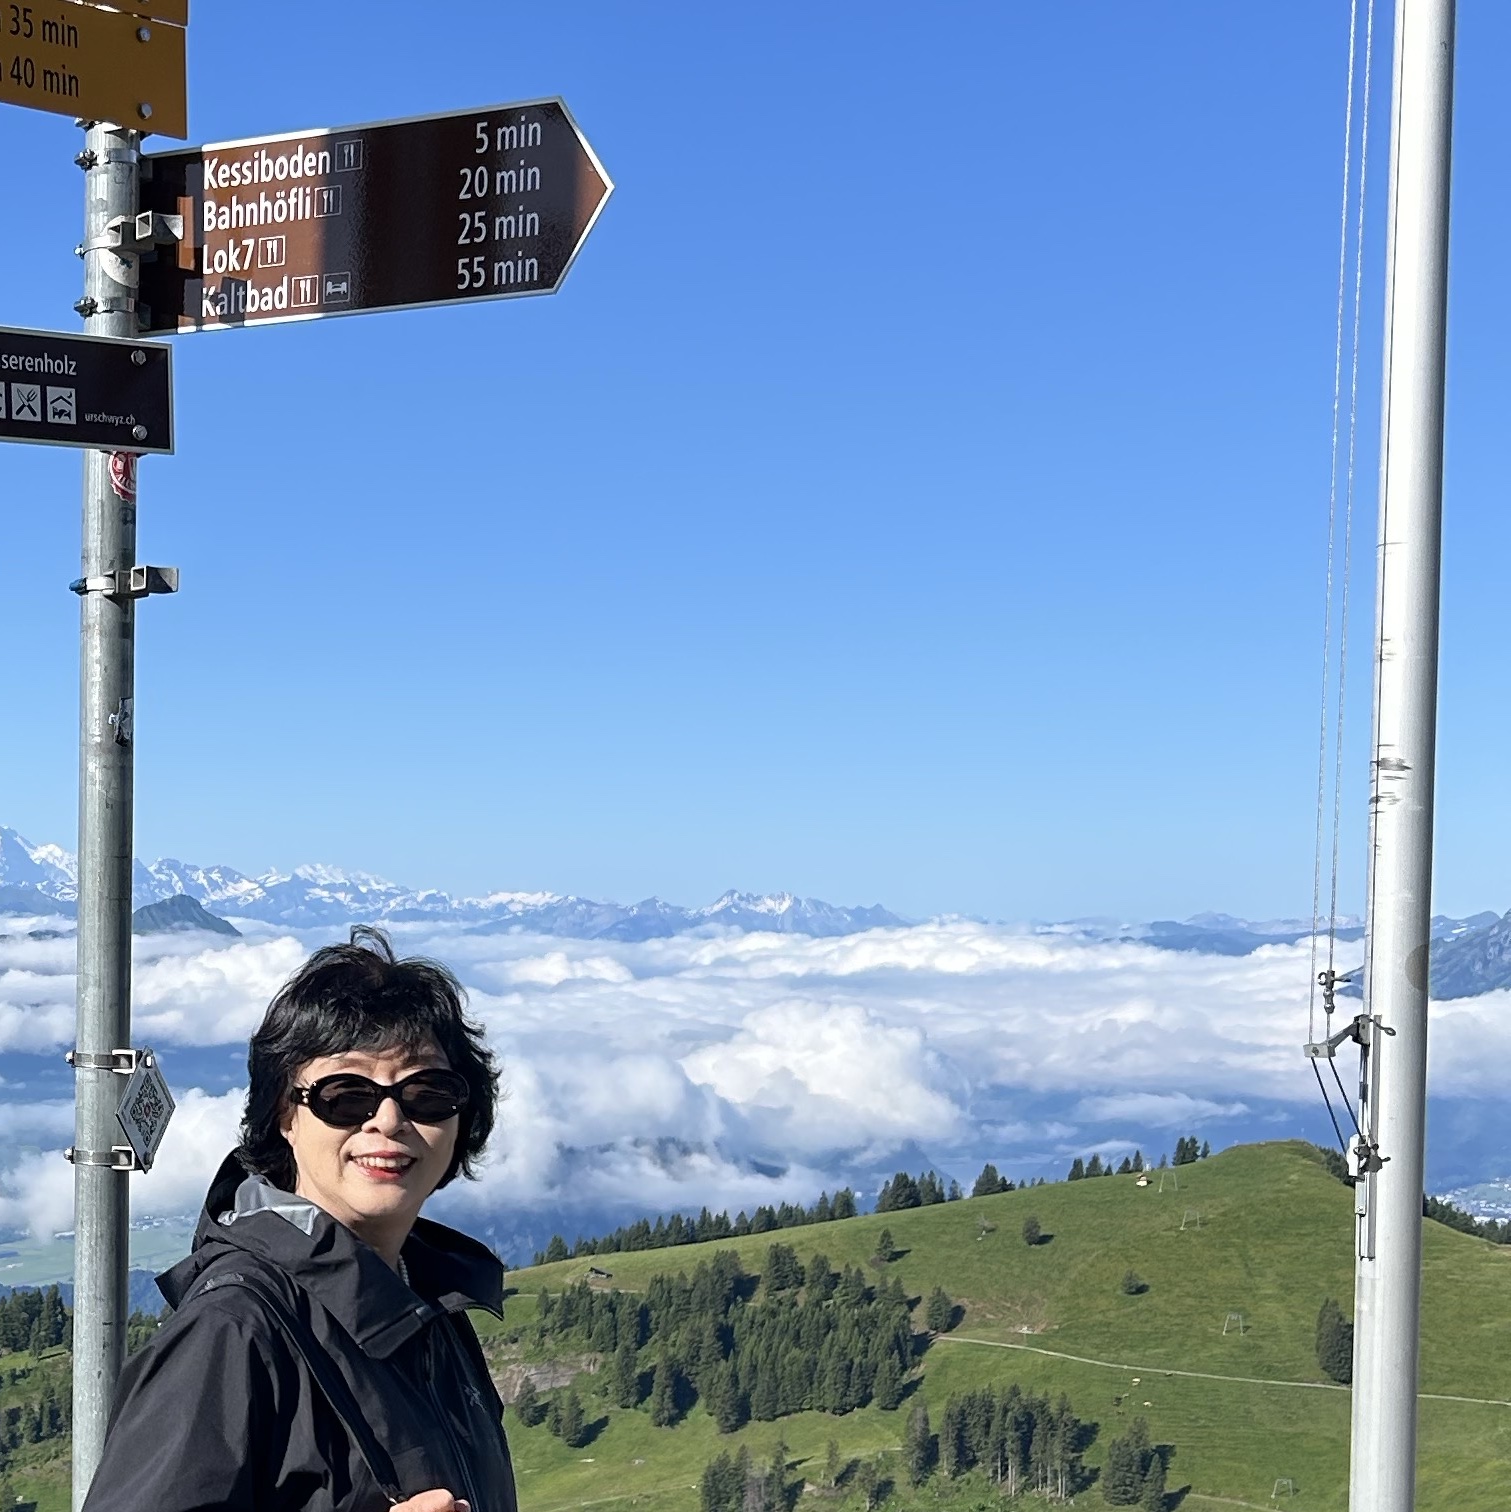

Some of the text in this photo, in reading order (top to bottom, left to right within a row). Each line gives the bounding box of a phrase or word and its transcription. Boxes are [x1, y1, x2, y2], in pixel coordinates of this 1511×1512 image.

[9, 4, 34, 39] 35
[41, 15, 80, 49] min
[9, 55, 36, 89] 40
[42, 64, 80, 98] min
[202, 115, 543, 190] Kessiboden 5 min
[202, 160, 542, 232] Bahnhöfli 20 min
[201, 205, 541, 274] Lok7 25 min
[201, 251, 540, 318] Kaltbad 55 min
